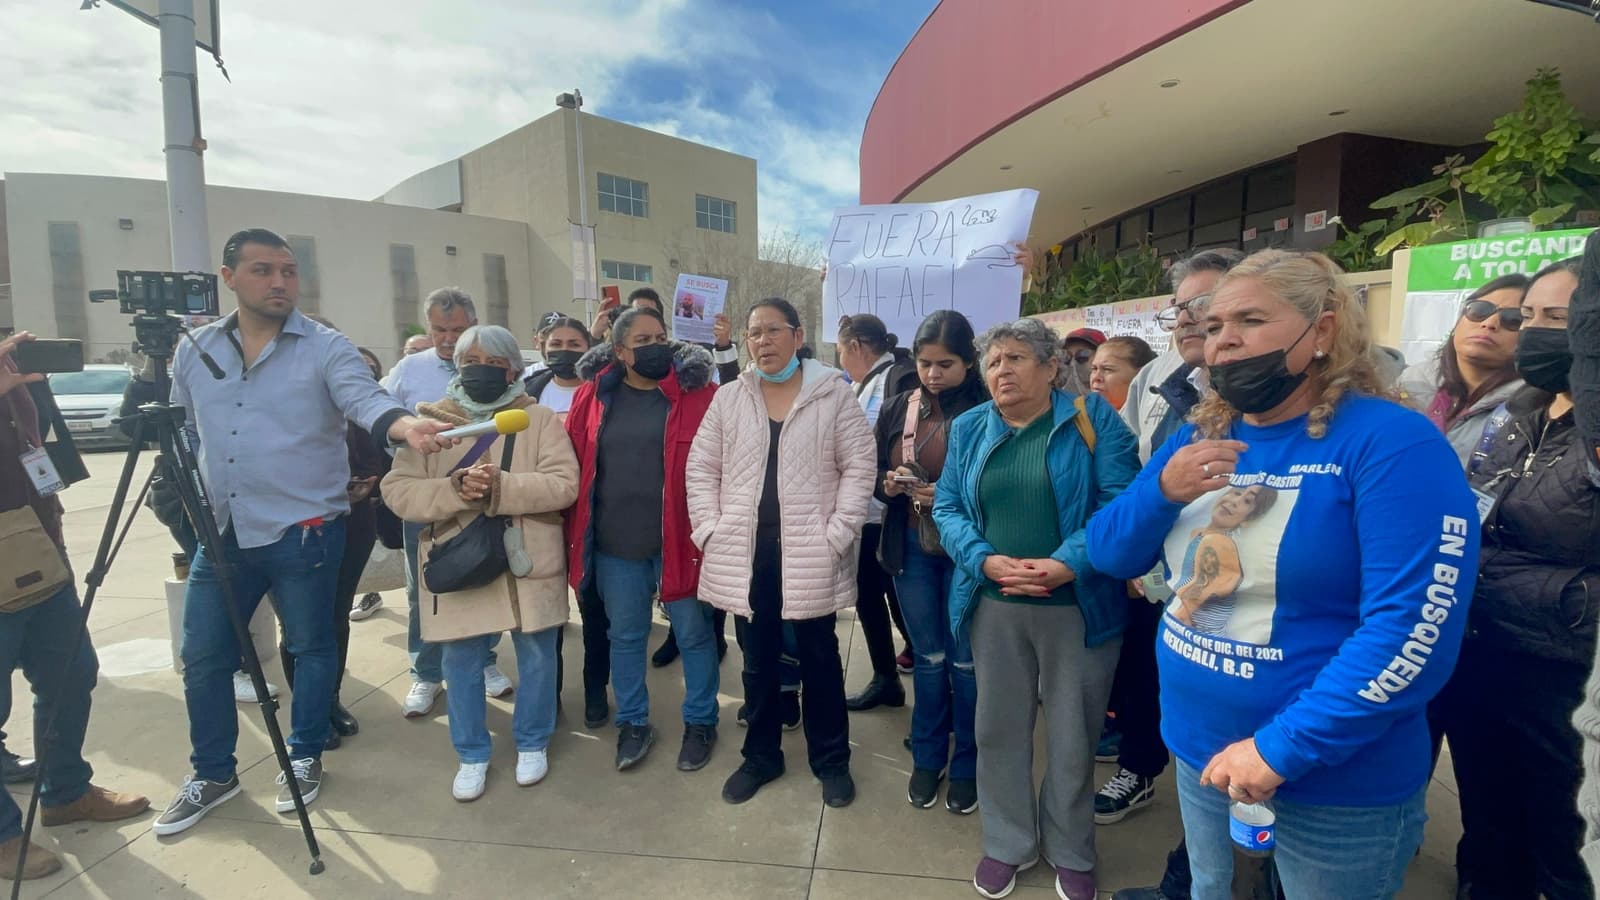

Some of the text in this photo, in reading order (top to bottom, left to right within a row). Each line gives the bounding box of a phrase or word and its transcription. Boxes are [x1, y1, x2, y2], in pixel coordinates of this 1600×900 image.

[828, 210, 958, 260] FUERA
[1453, 263, 1471, 280] A
[1116, 319, 1142, 330] FUERA
[1289, 463, 1342, 476] MARLEN
[1265, 474, 1304, 488] CASTRO
[1357, 515, 1467, 704] EN BÚSQUEDA
[1214, 641, 1234, 656] DIC.
[1236, 644, 1254, 659] DEL
[1255, 647, 1284, 661] 2021
[1223, 657, 1254, 679] B.C
